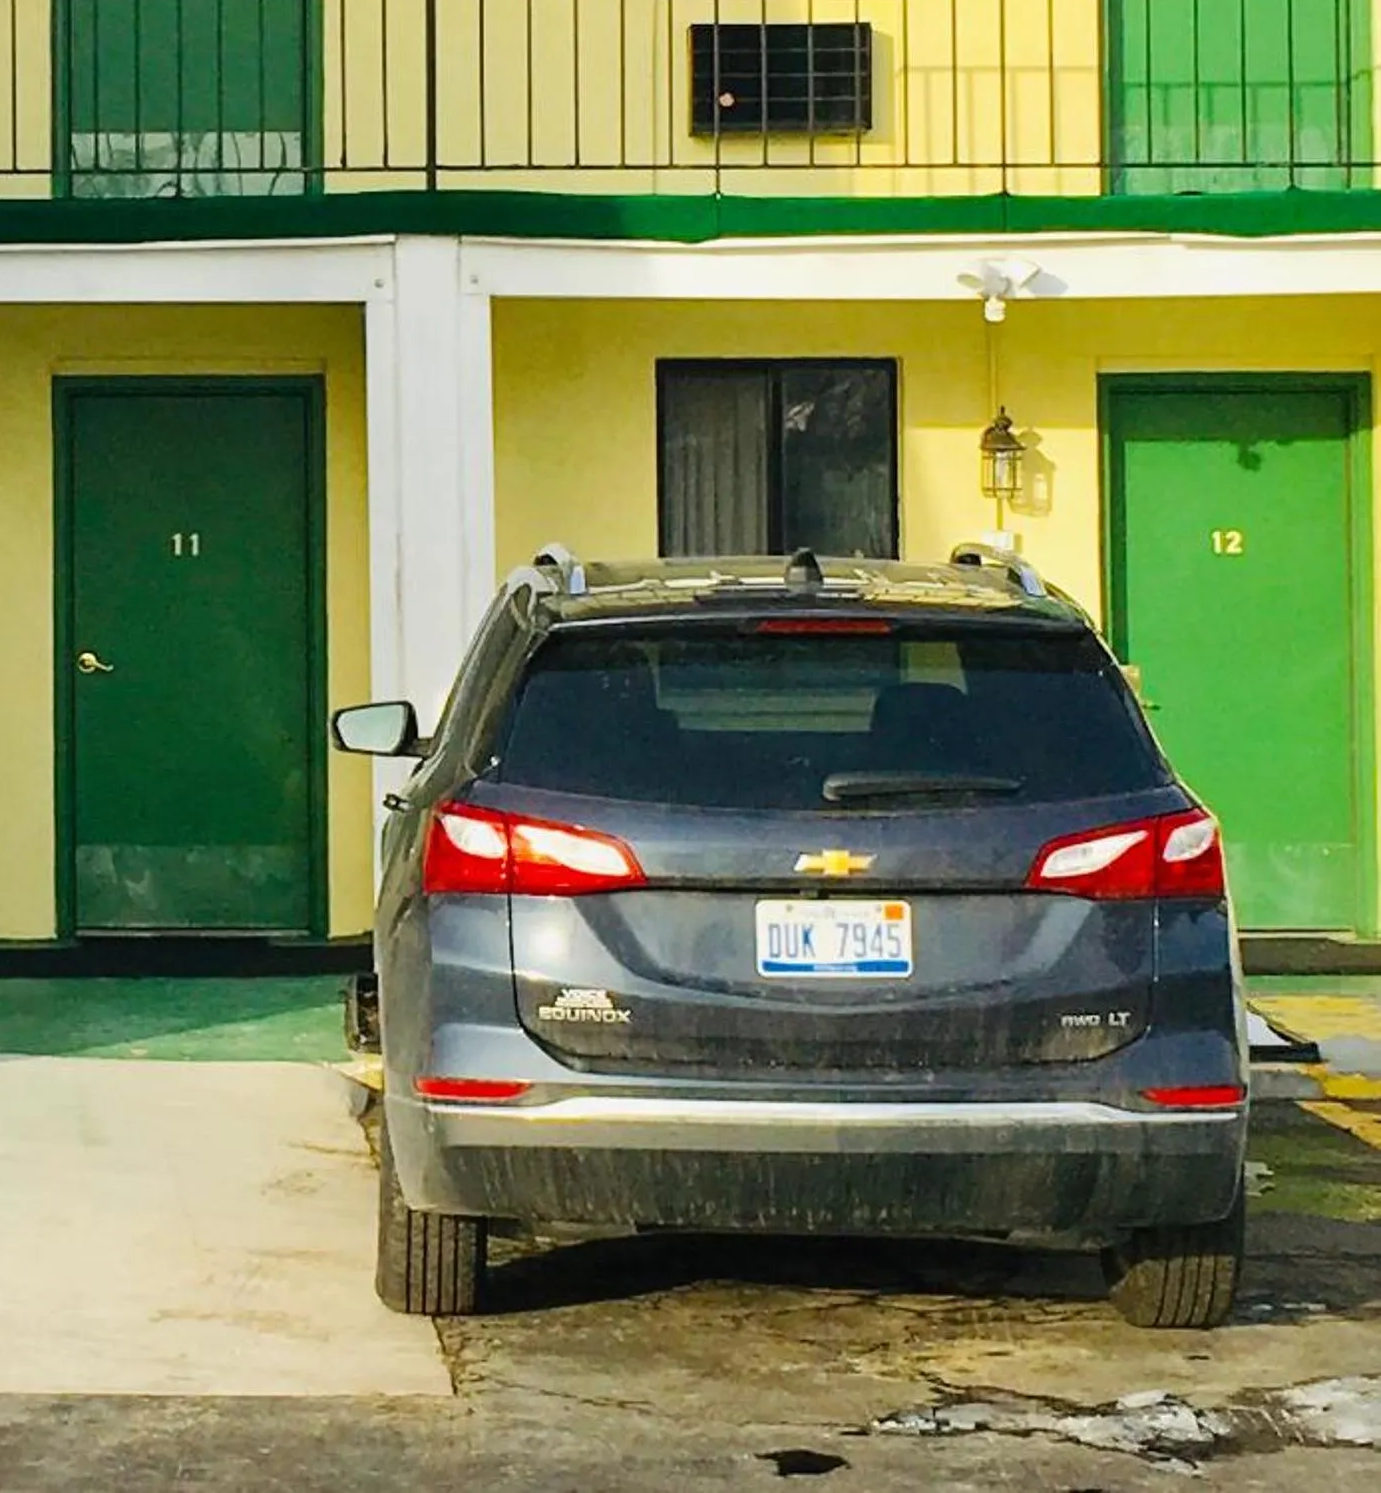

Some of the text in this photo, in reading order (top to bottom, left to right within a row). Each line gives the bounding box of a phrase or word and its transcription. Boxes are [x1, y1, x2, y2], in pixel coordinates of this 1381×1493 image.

[171, 532, 199, 557] 11
[1211, 530, 1243, 554] 12
[767, 922, 903, 959] DUK 7945
[538, 1005, 633, 1024] EQUINOX
[1108, 1011, 1131, 1027] LT
